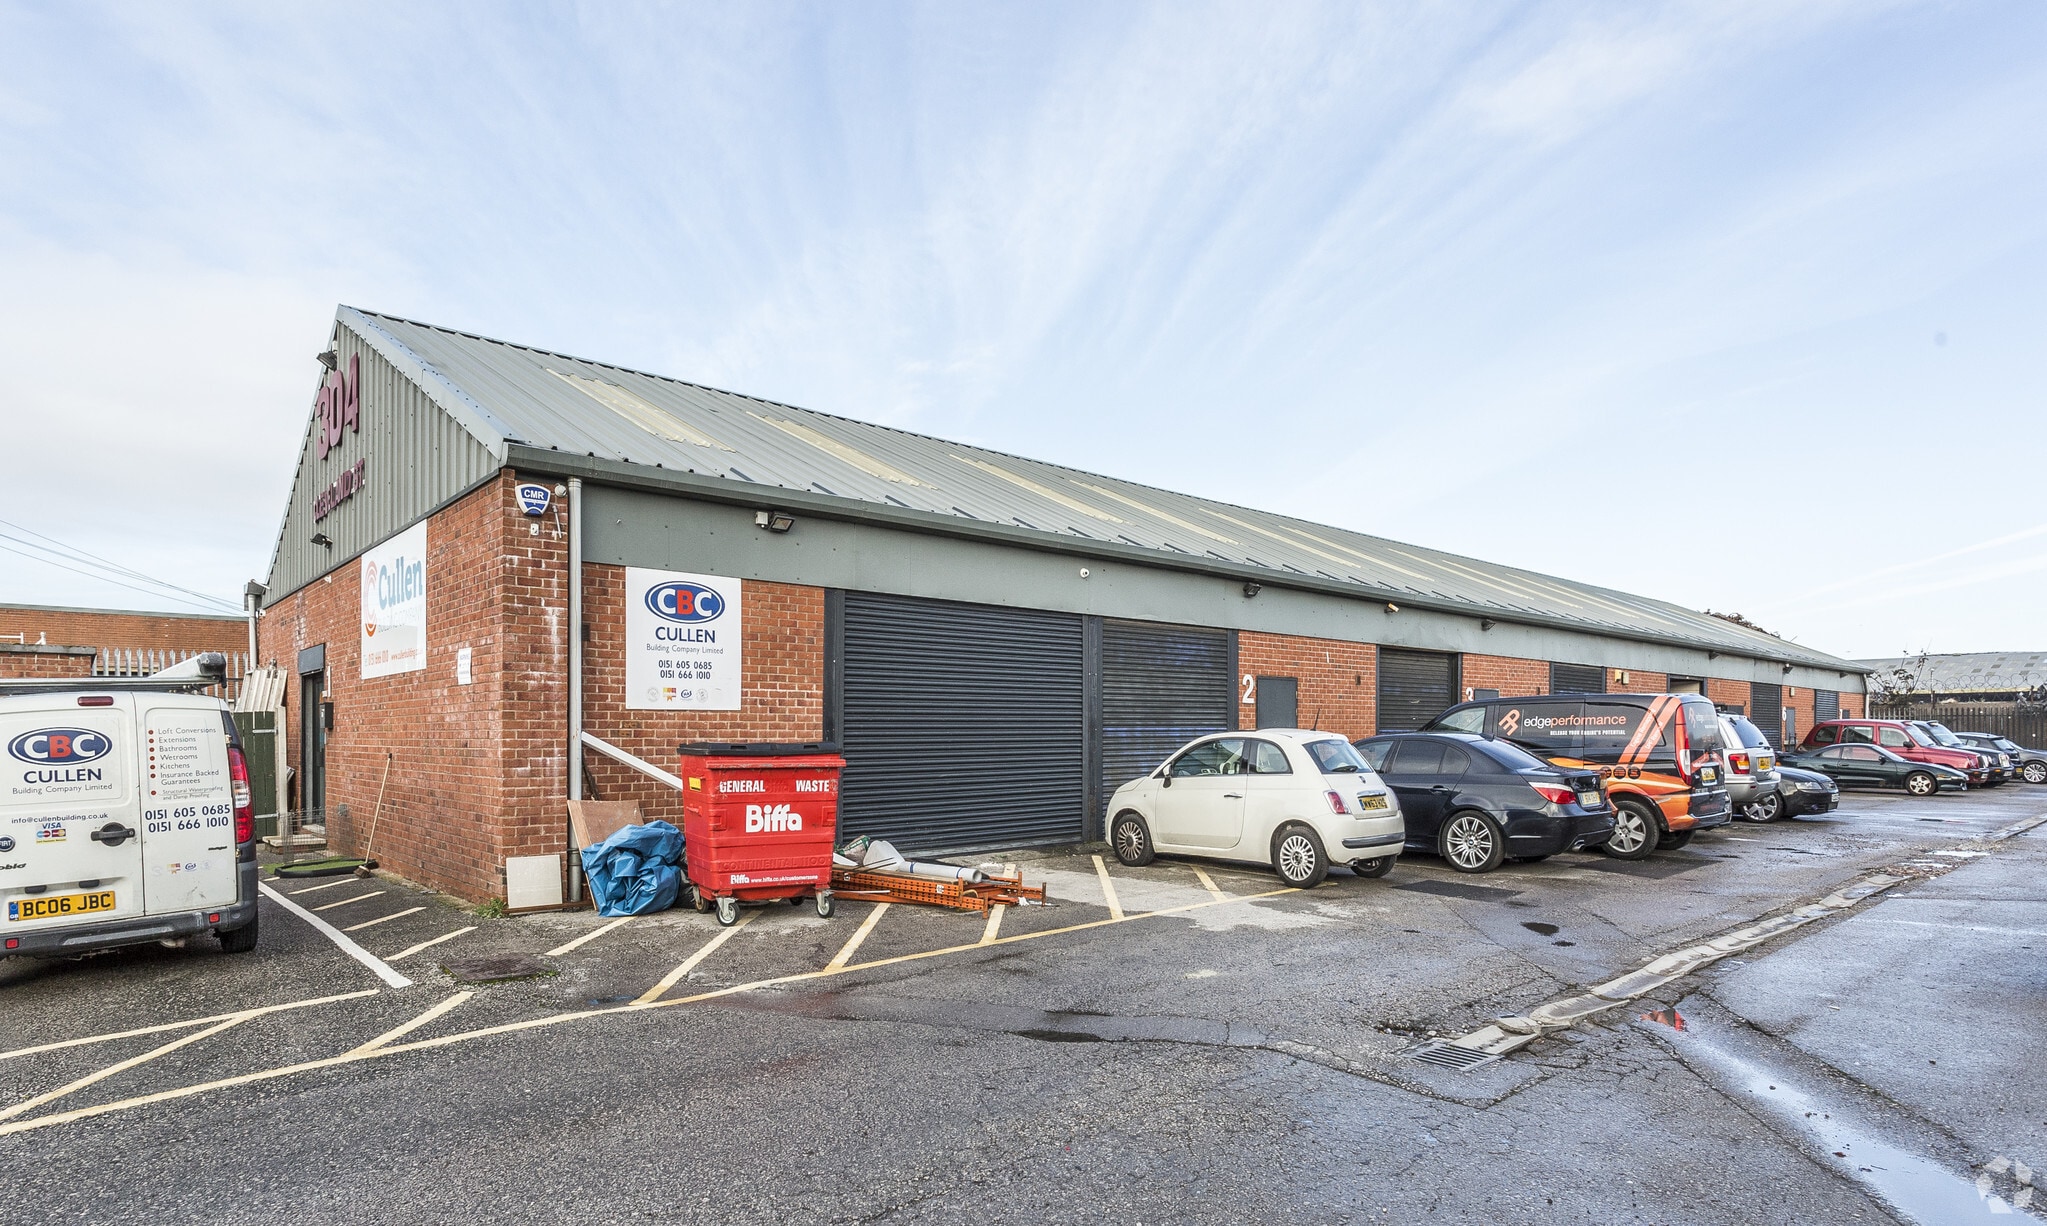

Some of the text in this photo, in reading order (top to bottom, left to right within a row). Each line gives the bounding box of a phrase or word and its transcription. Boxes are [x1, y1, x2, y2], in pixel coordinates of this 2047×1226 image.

[316, 352, 359, 460] 304
[524, 489, 545, 500] CMR
[379, 556, 423, 610] Cullen
[657, 588, 713, 617] CBC
[655, 626, 716, 643] CULLEN
[646, 643, 670, 654] Building
[671, 645, 700, 655] Company
[658, 660, 713, 670] 0151 605 0685
[660, 670, 711, 680] 0151 666 1010
[1242, 674, 1255, 704] 2
[175, 727, 217, 735] Conversions
[24, 734, 96, 759] CBC
[158, 736, 197, 744] Extensions
[23, 768, 102, 784] CULLEN
[161, 778, 201, 786] Guarantees
[12, 783, 113, 795] Building Company Limited
[719, 780, 830, 793] GENERAL WASTE
[11, 812, 109, 824] info@cullenbuilding.co.uk
[145, 804, 231, 821] 0151 605 0685
[745, 803, 803, 833] Biffa
[148, 816, 229, 833] 0151 666 1010
[730, 874, 750, 885] Biffa
[23, 893, 112, 917] BC06 JBC
